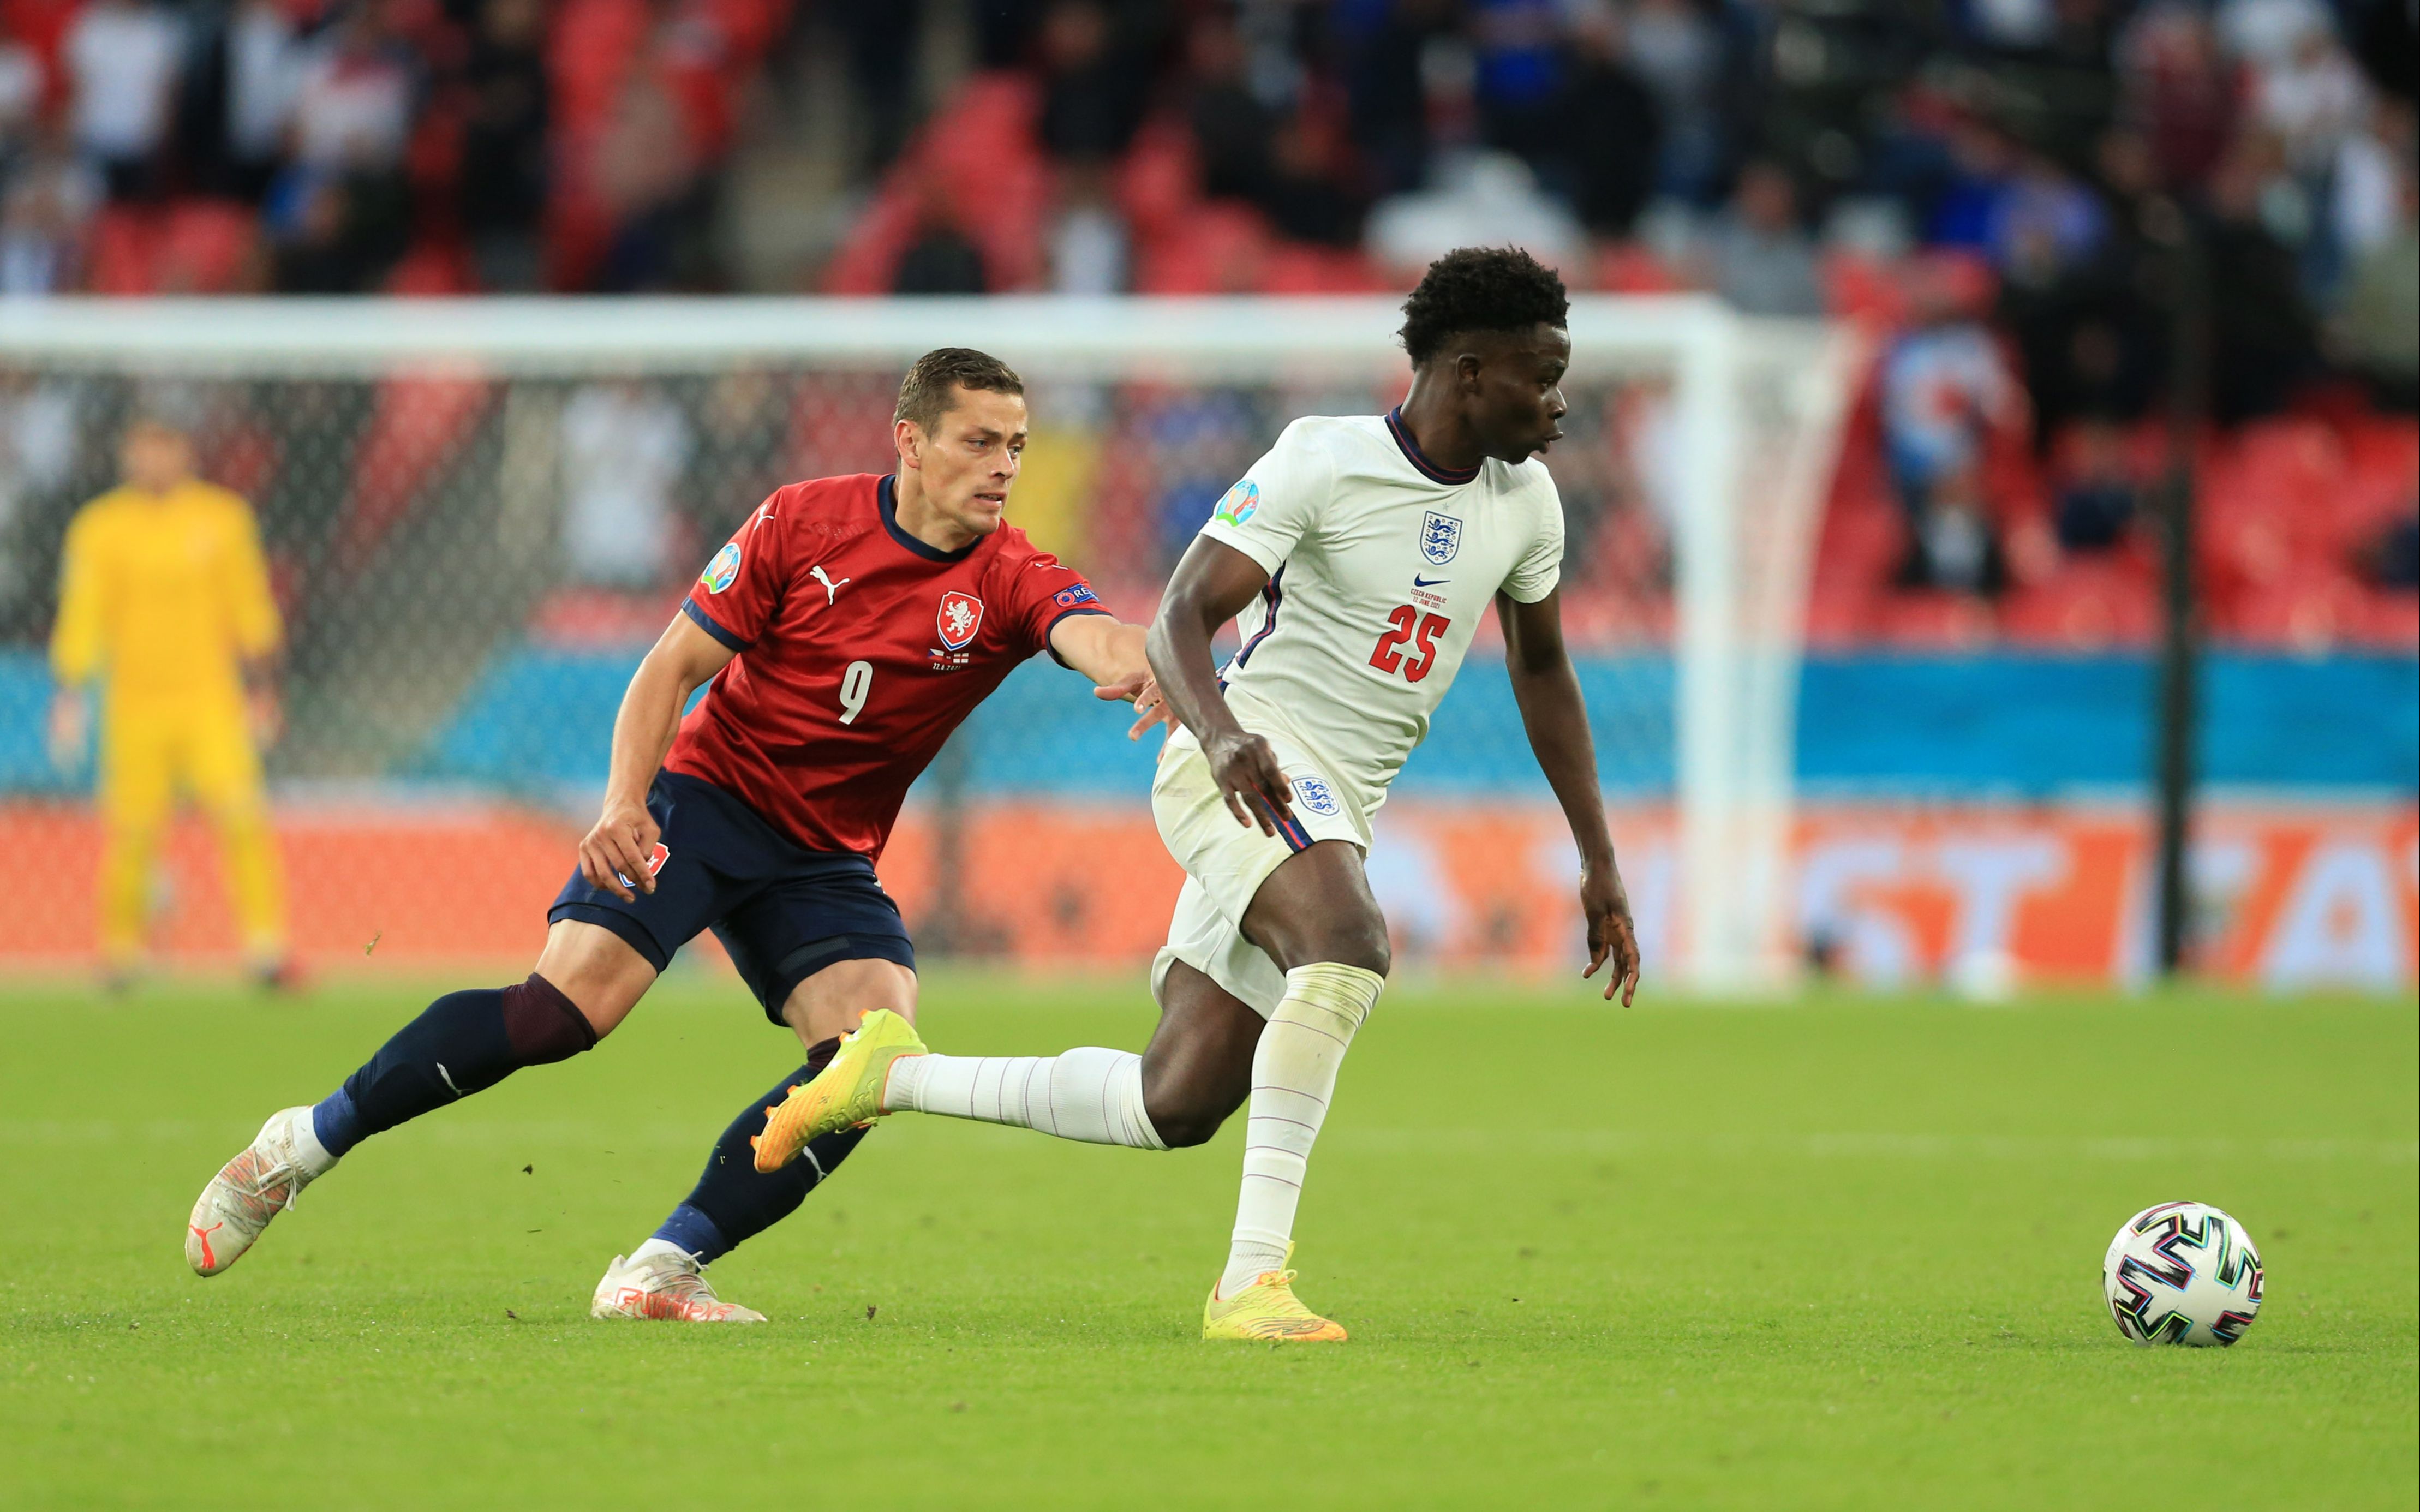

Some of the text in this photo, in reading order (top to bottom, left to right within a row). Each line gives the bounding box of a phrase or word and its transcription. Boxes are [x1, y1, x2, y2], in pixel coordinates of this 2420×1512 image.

[1411, 588, 1447, 603] CZECH REPUBLIC
[1369, 604, 1451, 683] 25
[839, 660, 873, 725] 9
